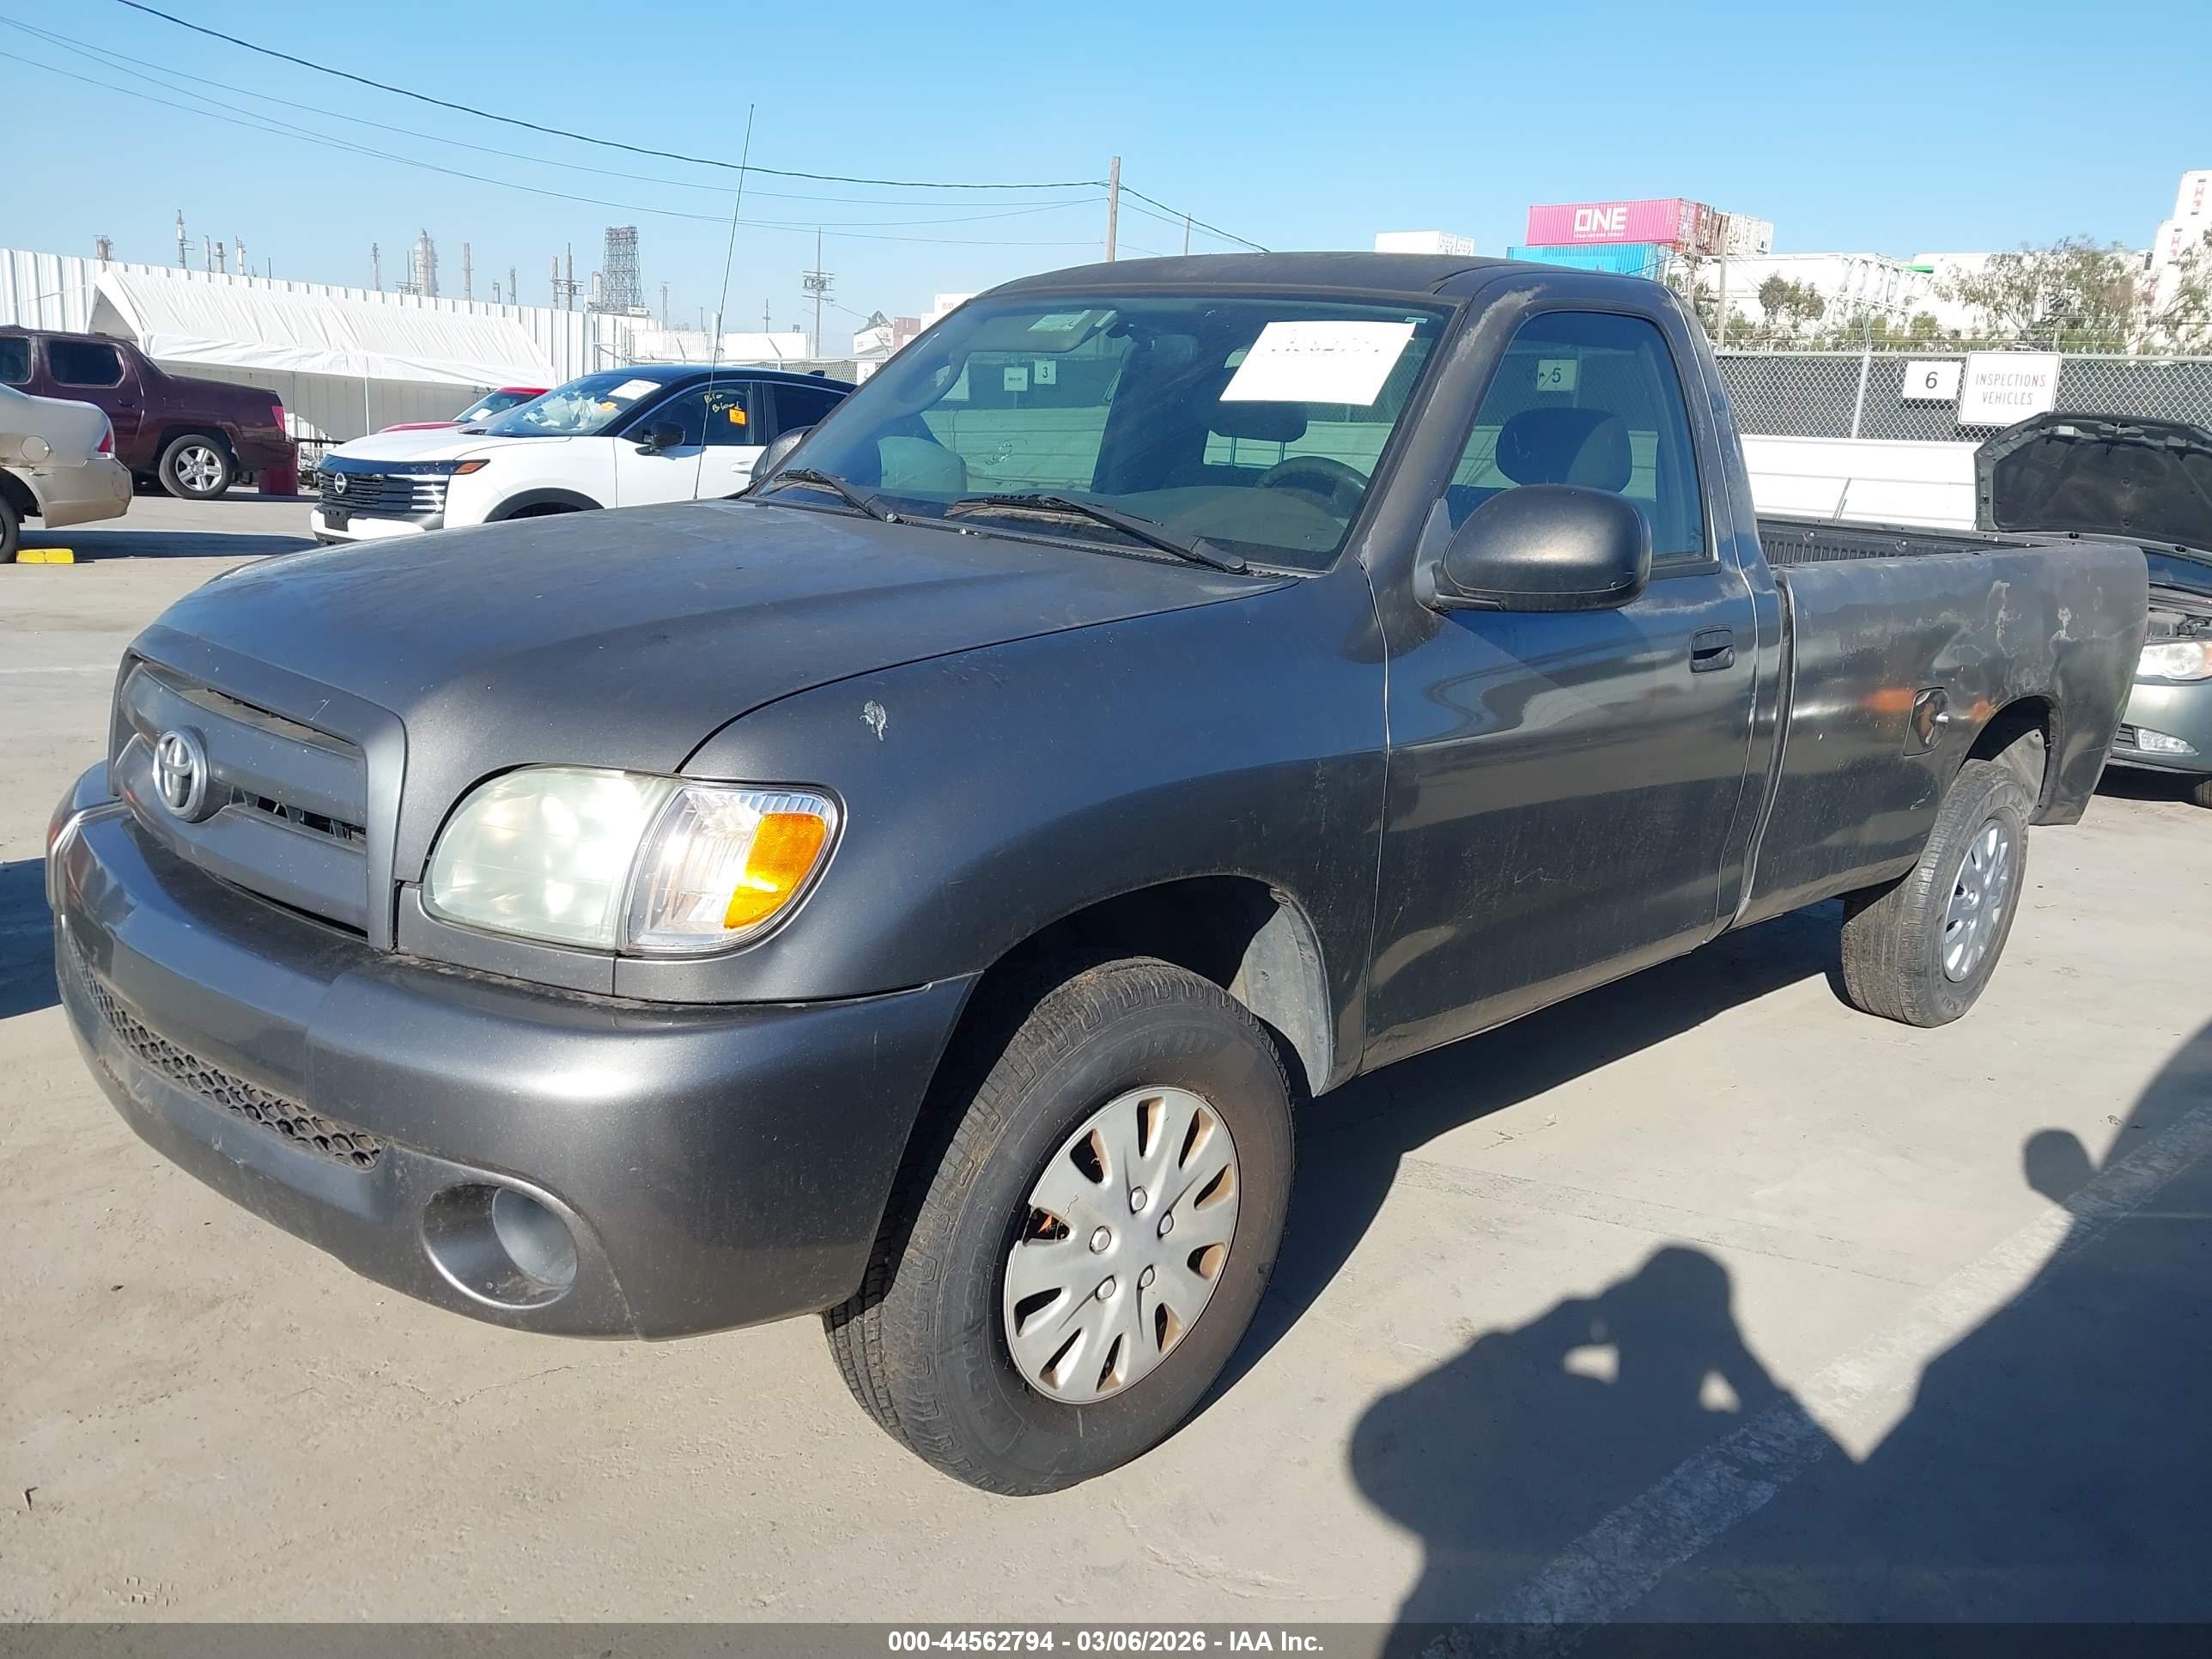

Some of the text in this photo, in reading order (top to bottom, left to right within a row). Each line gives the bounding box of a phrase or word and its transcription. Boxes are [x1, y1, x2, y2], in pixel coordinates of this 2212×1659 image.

[1575, 208, 1627, 231] ONE
[1042, 367, 1048, 379] 3
[1553, 368, 1561, 383] 5
[1975, 373, 2046, 387] INSPECTIONS
[1925, 372, 1938, 389] 6
[1982, 392, 2033, 405] VEHICLES
